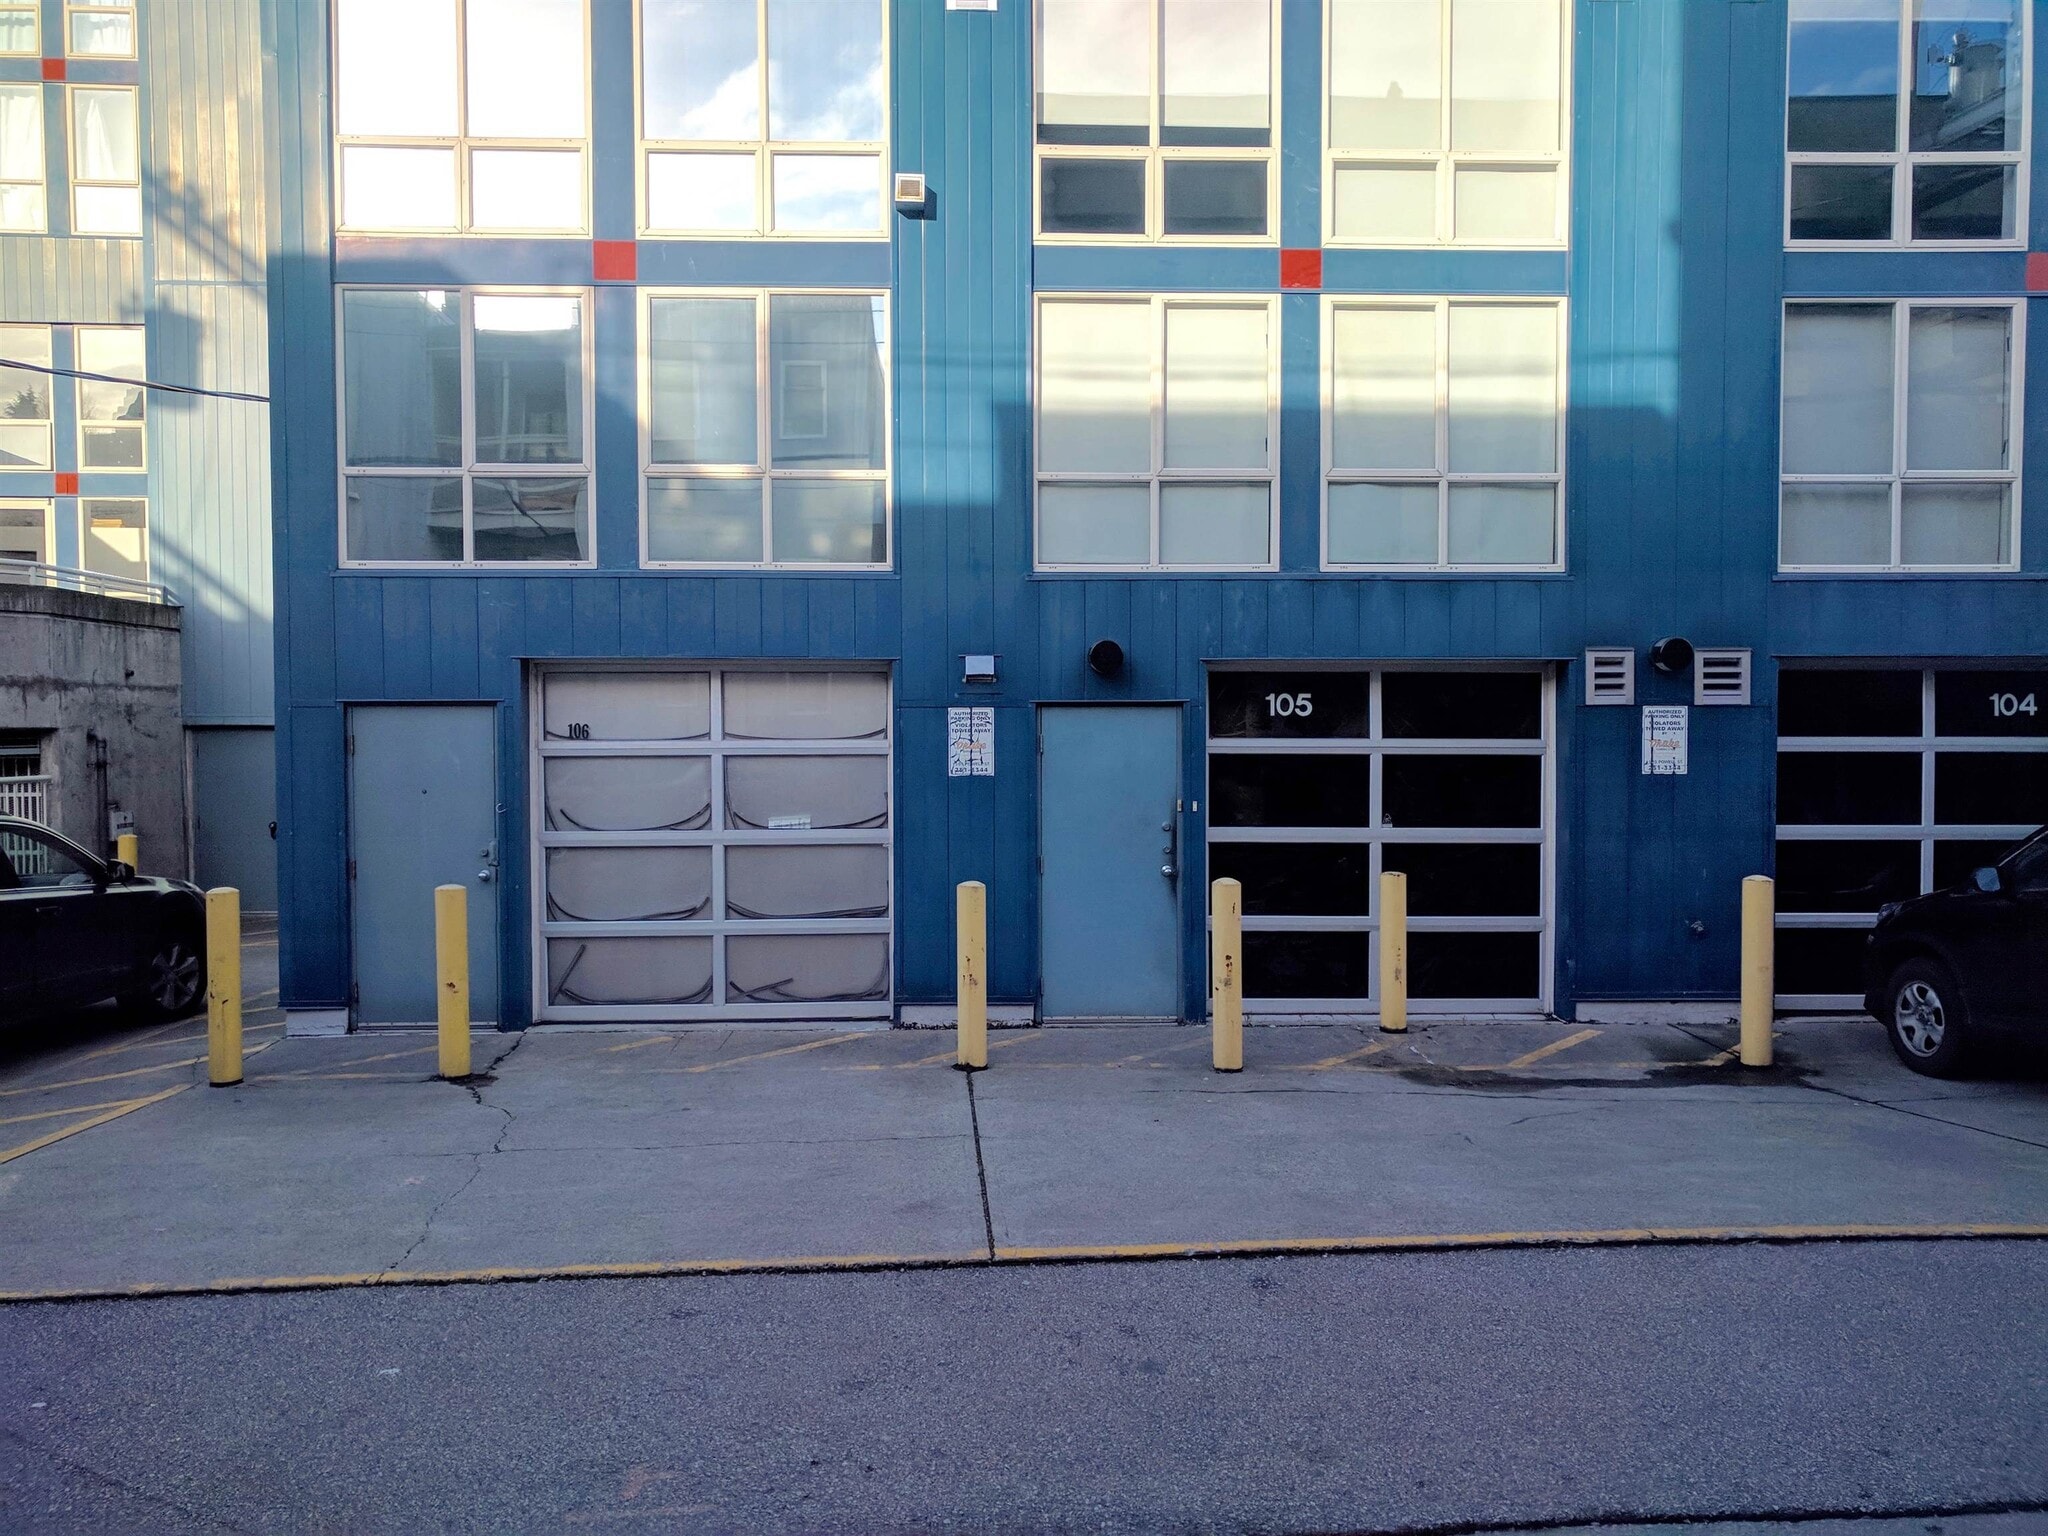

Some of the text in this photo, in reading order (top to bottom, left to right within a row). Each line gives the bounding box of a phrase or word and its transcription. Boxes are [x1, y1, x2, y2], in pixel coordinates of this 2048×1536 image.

[1265, 693, 1313, 717] 105
[1989, 693, 2038, 717] 104
[568, 722, 589, 739] 106
